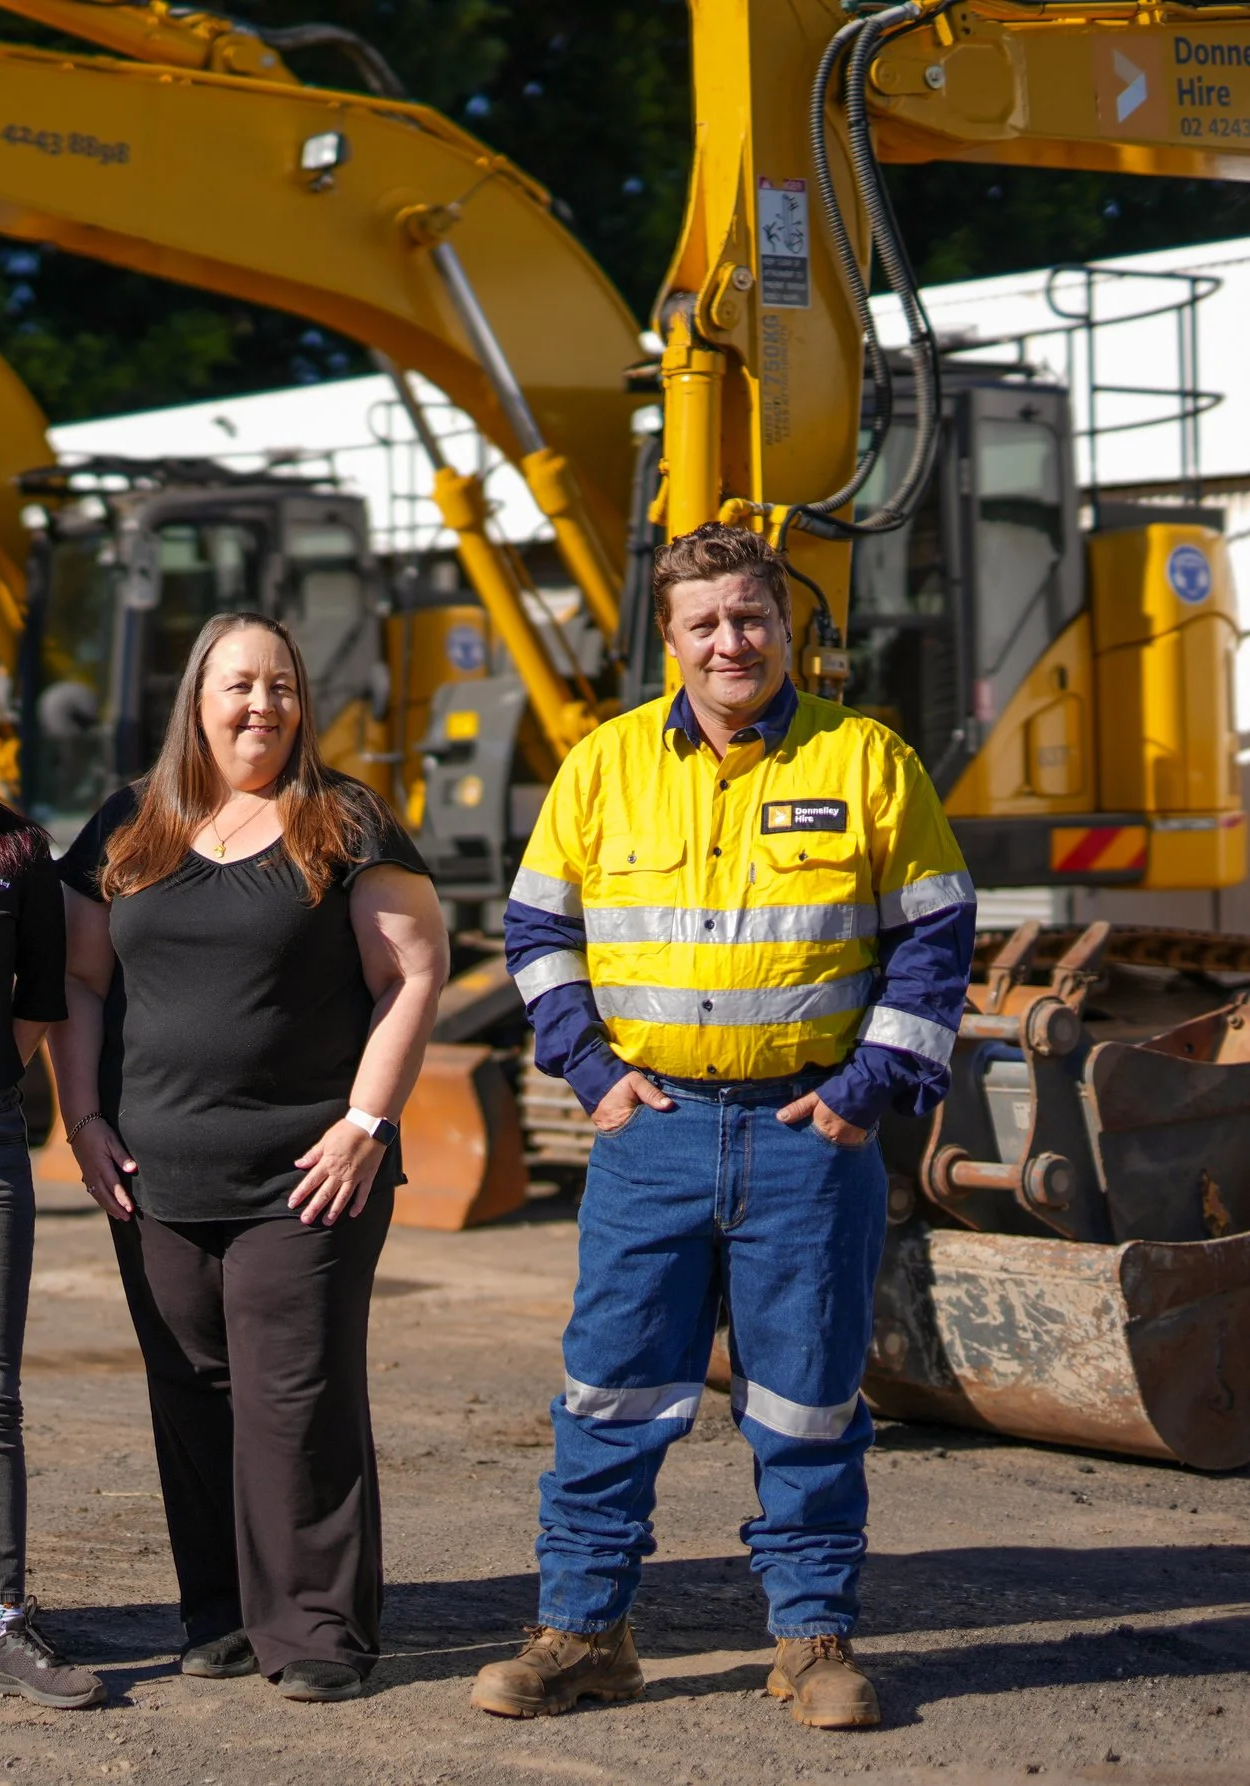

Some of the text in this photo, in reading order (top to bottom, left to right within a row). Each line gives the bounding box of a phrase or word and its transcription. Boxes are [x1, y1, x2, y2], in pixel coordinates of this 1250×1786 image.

[1177, 76, 1231, 106] Hire
[1180, 117, 1250, 137] 02 4243
[1, 123, 64, 156] 4243
[69, 132, 130, 166] 8898
[795, 806, 839, 817] Donnelley
[795, 815, 814, 824] Hire
